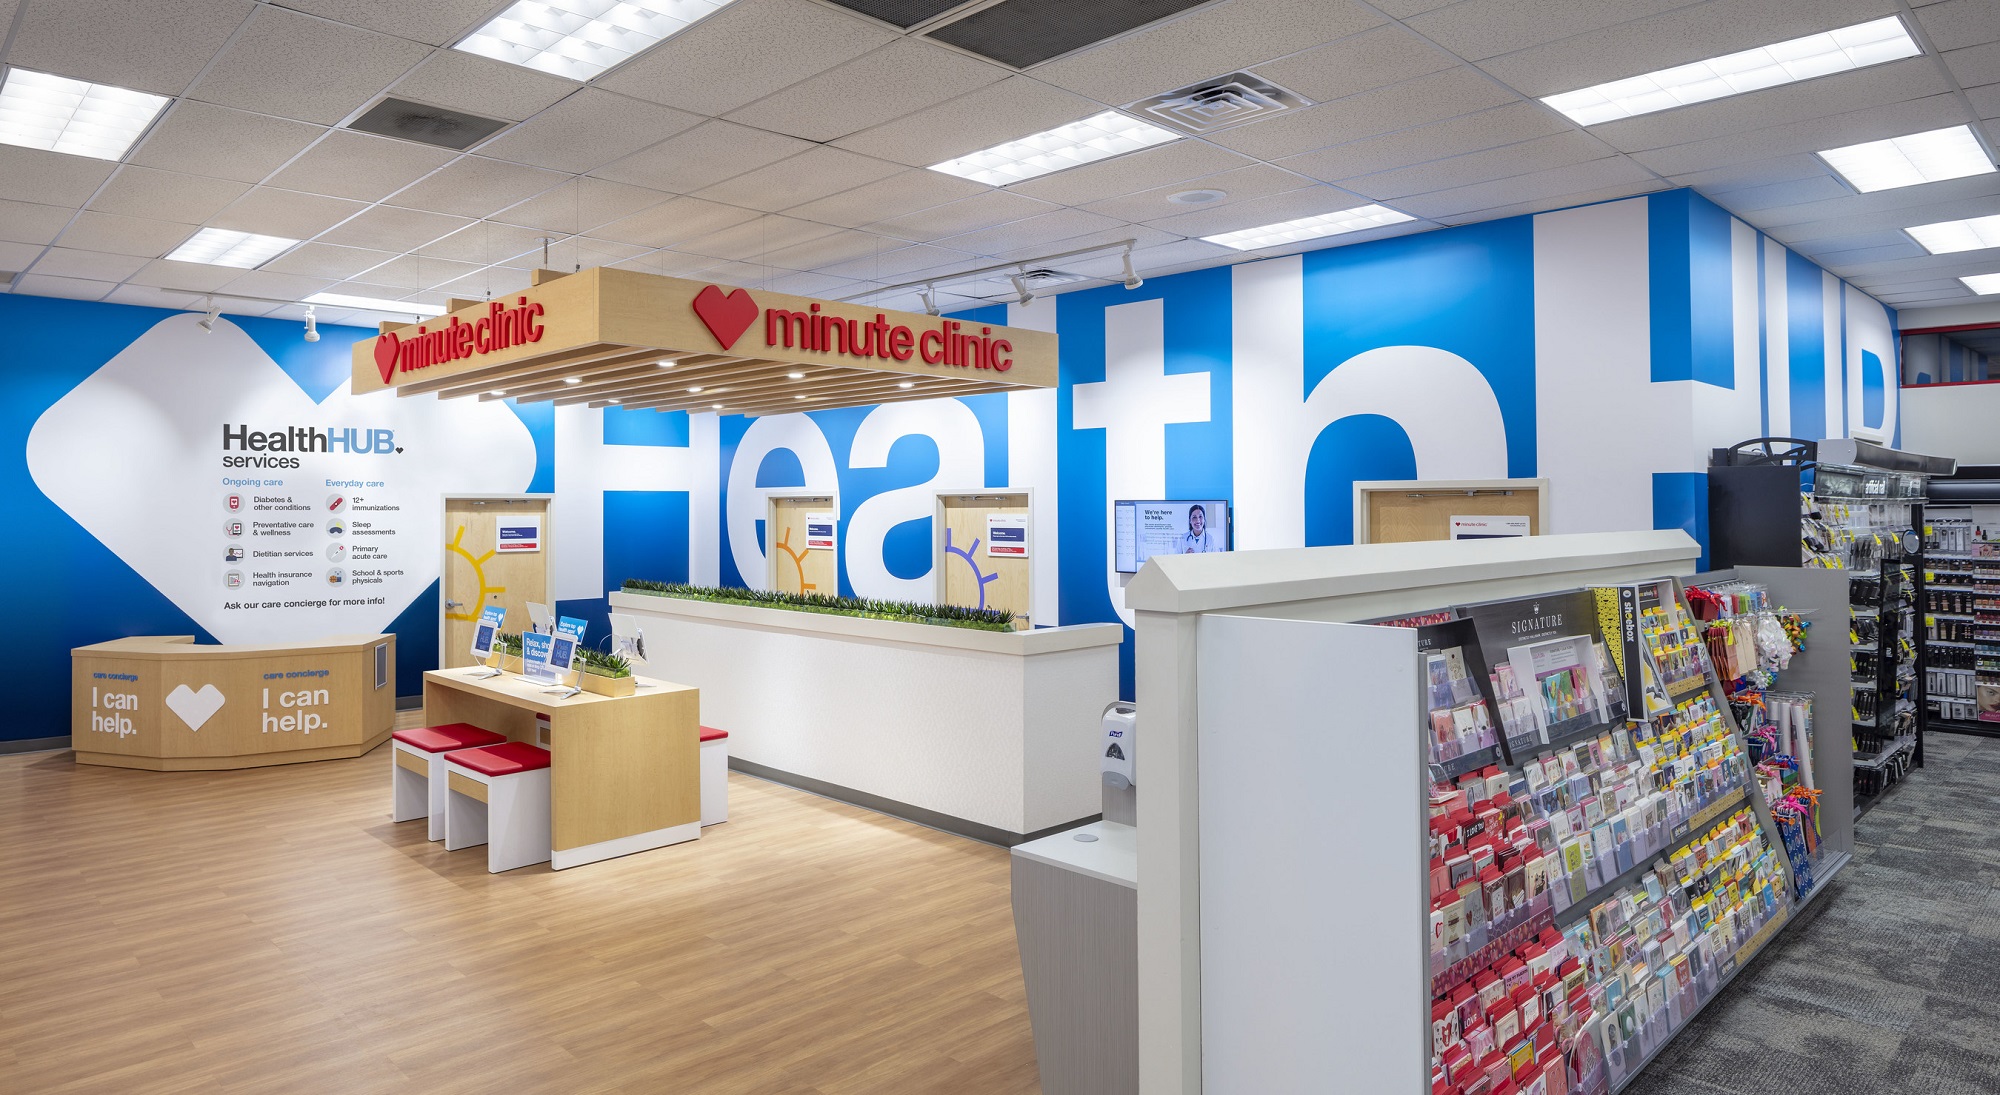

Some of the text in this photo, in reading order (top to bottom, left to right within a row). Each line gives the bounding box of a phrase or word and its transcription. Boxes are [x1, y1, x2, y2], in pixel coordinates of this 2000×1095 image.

[400, 296, 544, 373] minute clinic
[766, 303, 1013, 372] minute clinic
[222, 453, 300, 469] services
[222, 477, 261, 487] Ongoing
[325, 479, 364, 488] Everyday
[352, 521, 372, 529] Sleep
[253, 550, 282, 558] Dietitian
[352, 545, 379, 554] Primary
[383, 568, 404, 576] sports
[253, 579, 290, 587] navigation
[352, 576, 383, 585] physicals
[224, 601, 241, 610] Ask
[284, 599, 327, 609] concierge
[329, 598, 342, 606] for
[367, 597, 385, 605] info!
[1511, 613, 1563, 635] SIGNATURE
[1624, 601, 1635, 643] shoebox
[526, 637, 550, 650] Relax, sho
[531, 649, 547, 659] discov
[93, 672, 139, 682] care concierge
[263, 668, 330, 680] care concierge
[92, 686, 138, 711] I can
[262, 687, 329, 709] I can
[92, 711, 137, 738] help.
[262, 709, 328, 734] help.
